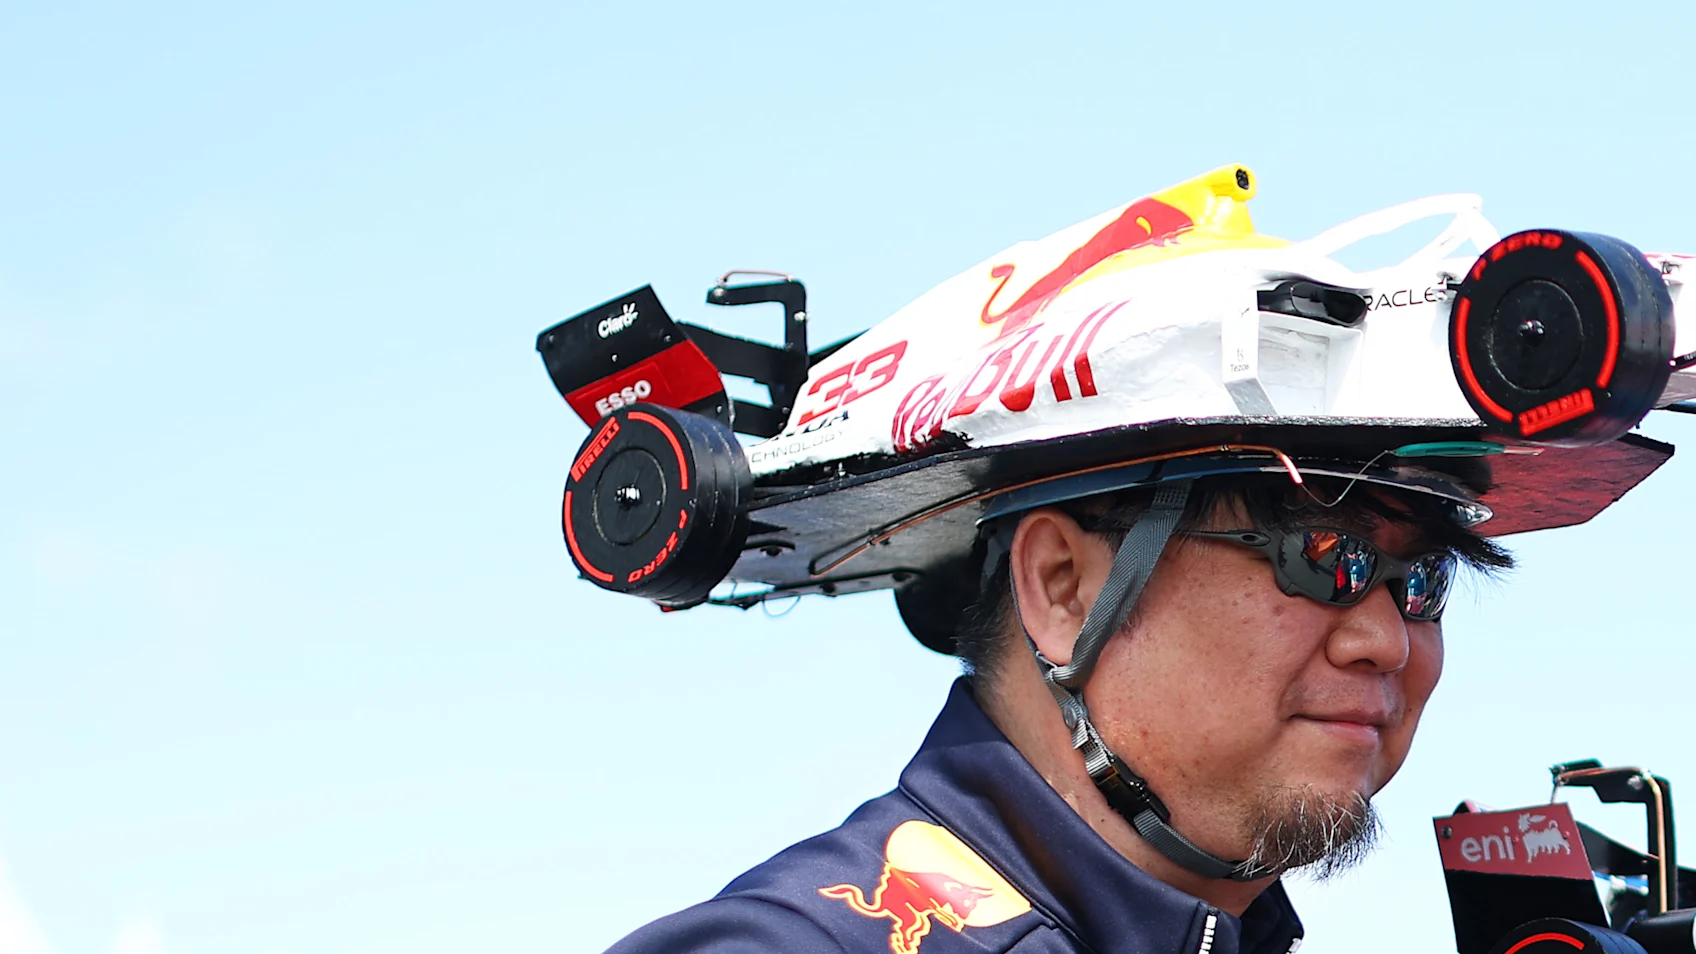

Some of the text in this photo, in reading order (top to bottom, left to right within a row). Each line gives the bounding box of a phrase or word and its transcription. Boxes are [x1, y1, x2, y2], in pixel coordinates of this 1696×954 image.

[1365, 286, 1441, 312] RACLE
[598, 304, 636, 338] Claro
[595, 379, 652, 418] ESSO
[797, 339, 908, 426] 33
[570, 416, 621, 482] PIRELLI
[751, 429, 844, 463] CHNOLOGY
[628, 531, 680, 583] ZERO
[1460, 826, 1516, 863] eni
